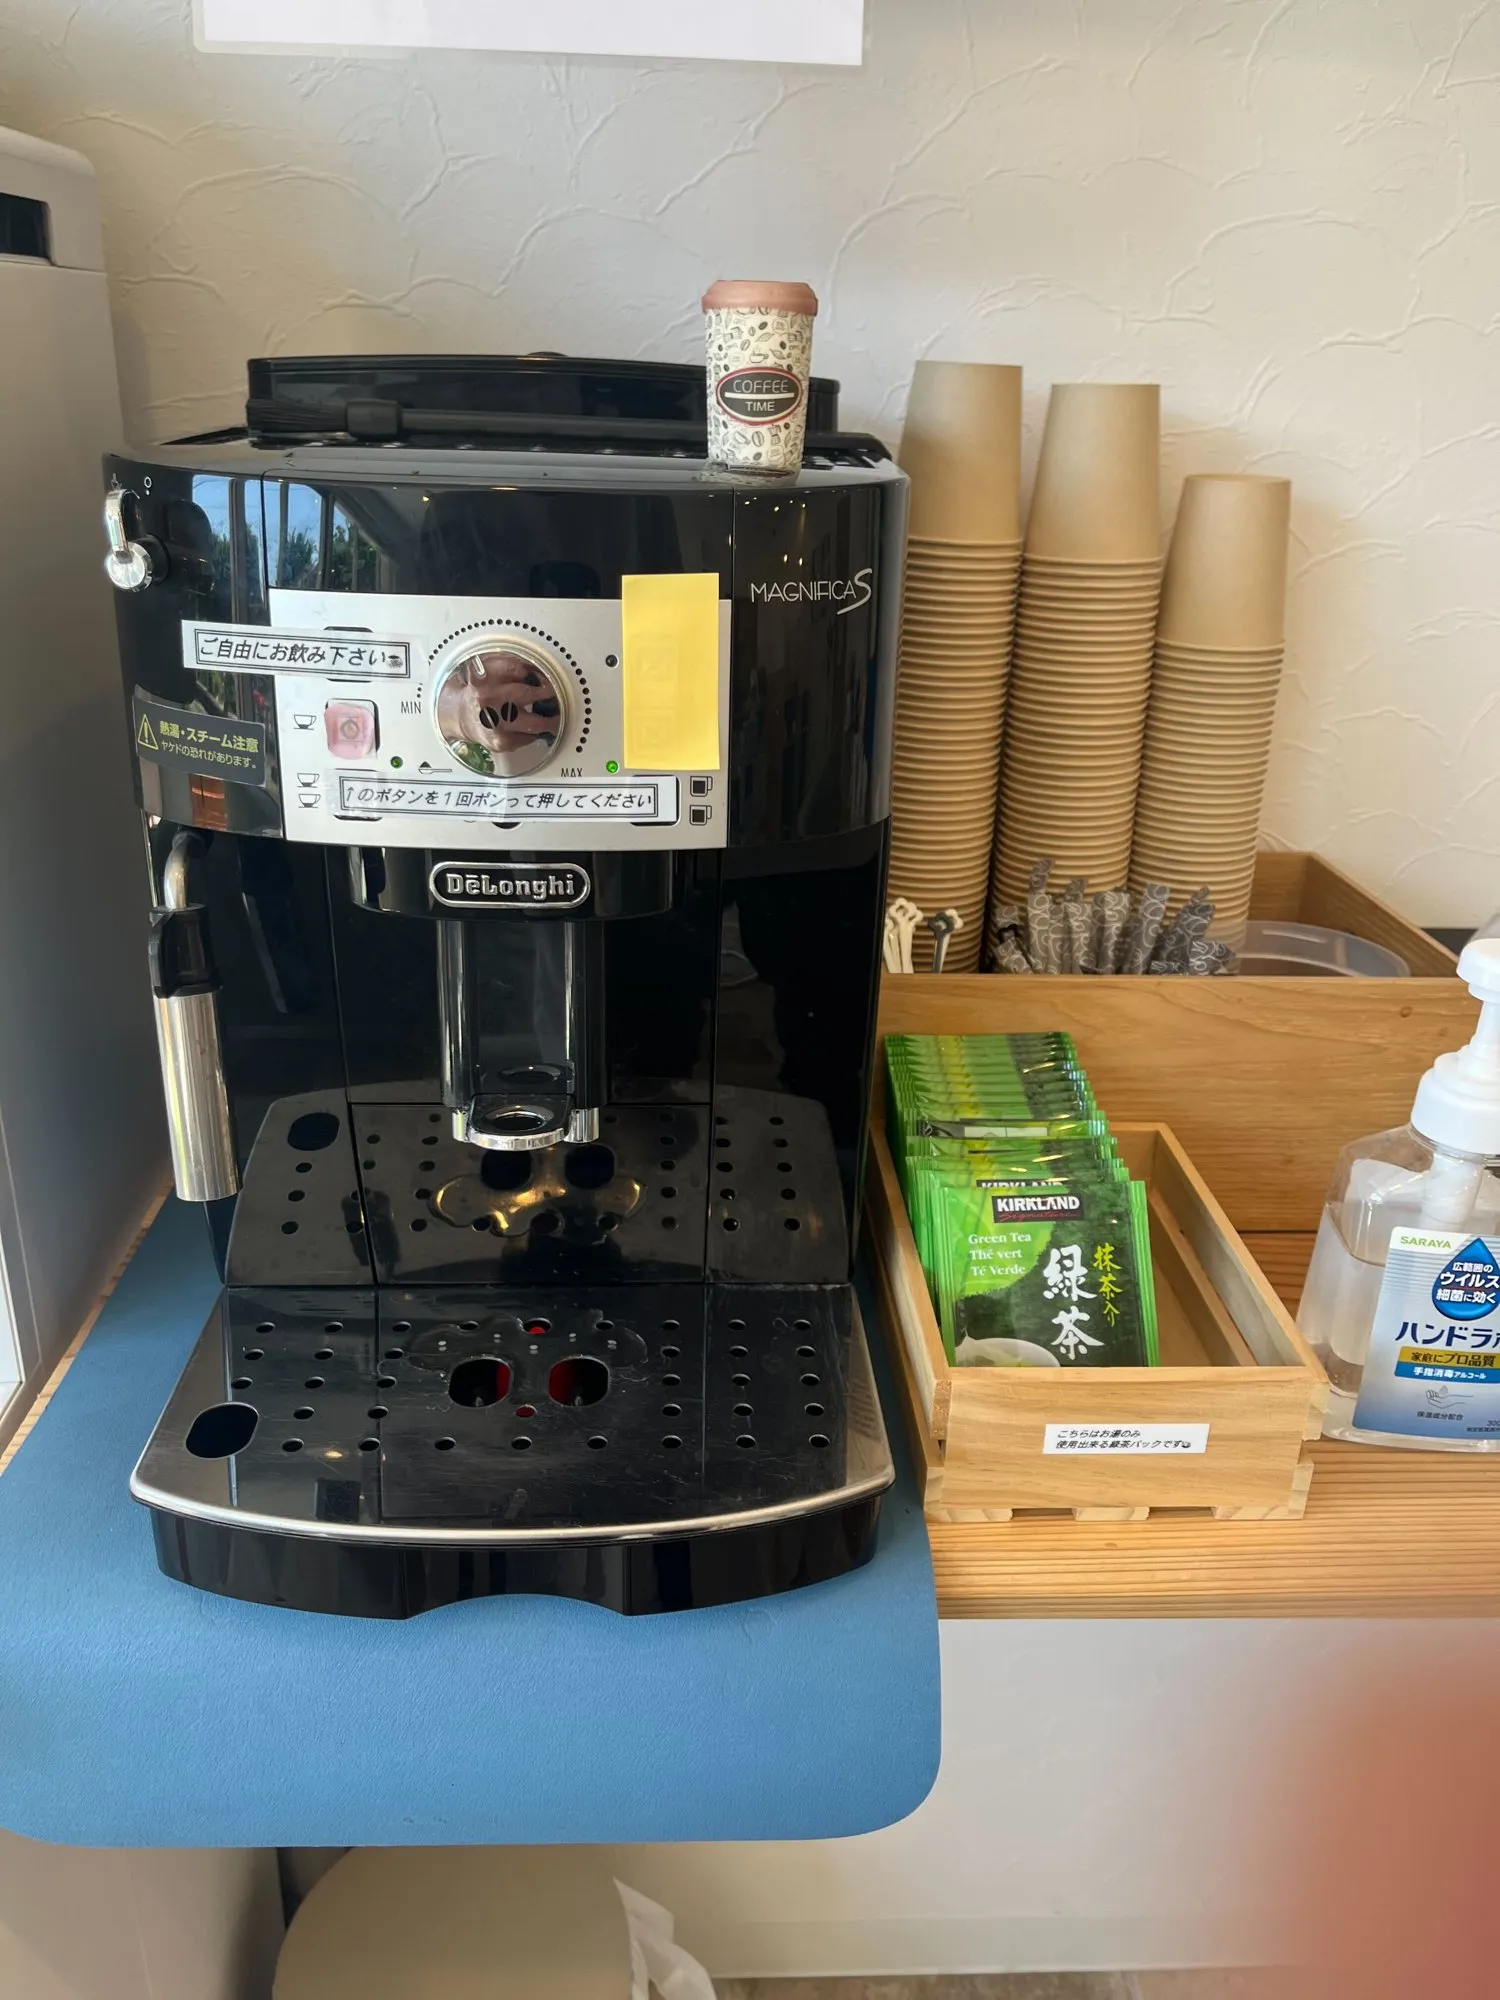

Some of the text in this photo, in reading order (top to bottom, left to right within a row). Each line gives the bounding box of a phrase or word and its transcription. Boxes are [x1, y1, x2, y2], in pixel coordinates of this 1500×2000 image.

[733, 379, 789, 394] COFFEE
[745, 401, 776, 412] TIME
[200, 636, 386, 666] ご自由にお飲み下さい
[400, 701, 422, 714] MIN
[159, 720, 259, 753] 熱湯・スチーム注意
[560, 767, 583, 778] MAX
[997, 1195, 1081, 1212] KIRKLAND
[968, 1232, 1032, 1245] Green Tea
[1400, 1236, 1452, 1249] SARAYA
[970, 1249, 1022, 1261] Thé vert
[971, 1264, 1026, 1276] Té Verde
[1452, 1262, 1494, 1273] 広範囲の
[1093, 1242, 1123, 1327] 抹茶入り
[1043, 1244, 1106, 1360] 緑茶
[1436, 1288, 1497, 1304] 細菌に効く
[1395, 1321, 1500, 1349] ハンドラ
[1410, 1352, 1497, 1368] 家庭にプロ品質
[1057, 1429, 1142, 1439] こちらはお湯のみ
